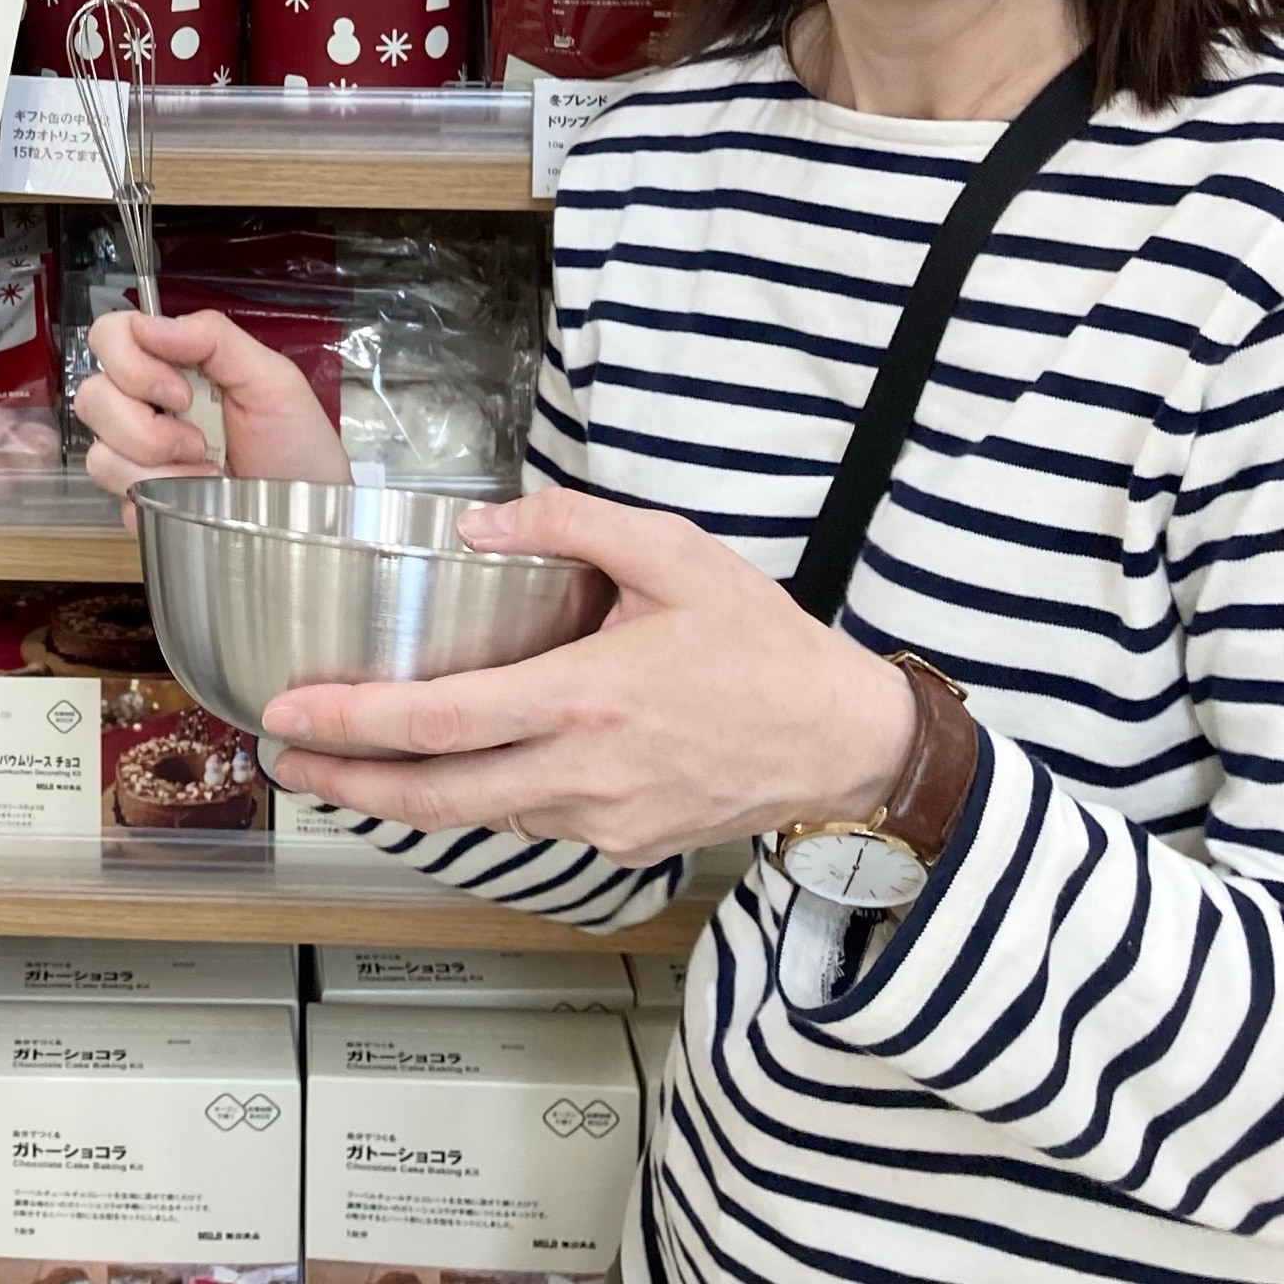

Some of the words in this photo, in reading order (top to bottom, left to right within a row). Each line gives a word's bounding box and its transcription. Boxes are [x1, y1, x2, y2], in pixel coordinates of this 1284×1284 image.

[550, 95, 607, 107] 冬ブレンド
[13, 128, 99, 144] カカオトリュフ
[56, 756, 81, 768] チョコ
[358, 962, 465, 974] ガトーショコラ
[24, 970, 134, 982] ガトーショコラ
[13, 1048, 127, 1061] ガトーショコラ
[347, 1050, 462, 1064] ガトーショコラ
[13, 1142, 127, 1160] ガトーショコラ
[346, 1145, 463, 1165] ガトーショコラ
